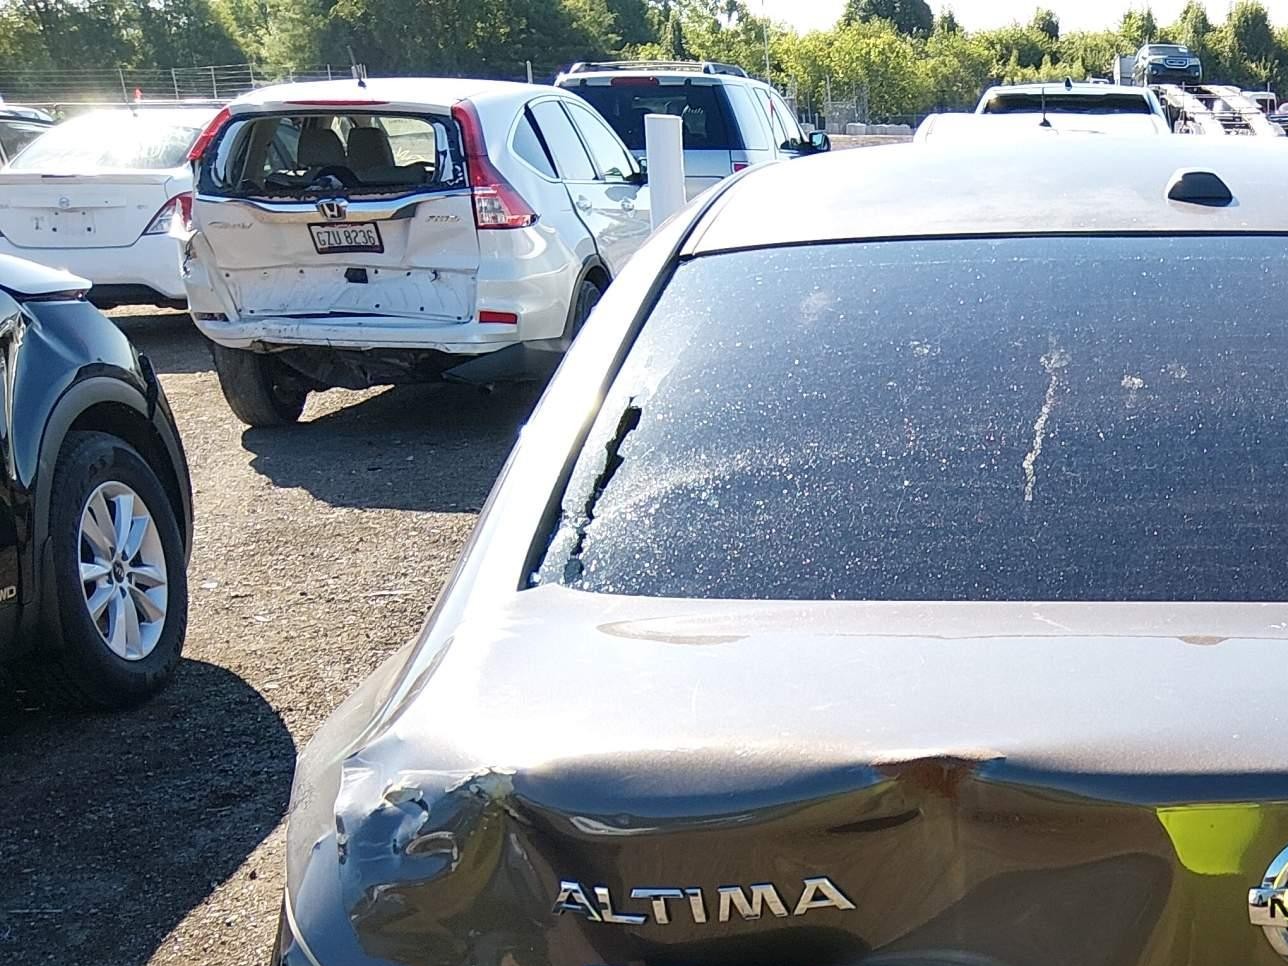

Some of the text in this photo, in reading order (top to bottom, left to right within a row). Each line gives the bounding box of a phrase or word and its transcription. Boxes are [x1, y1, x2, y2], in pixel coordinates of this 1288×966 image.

[316, 229, 376, 246] GZU 8236
[551, 877, 857, 925] ALTIMA
